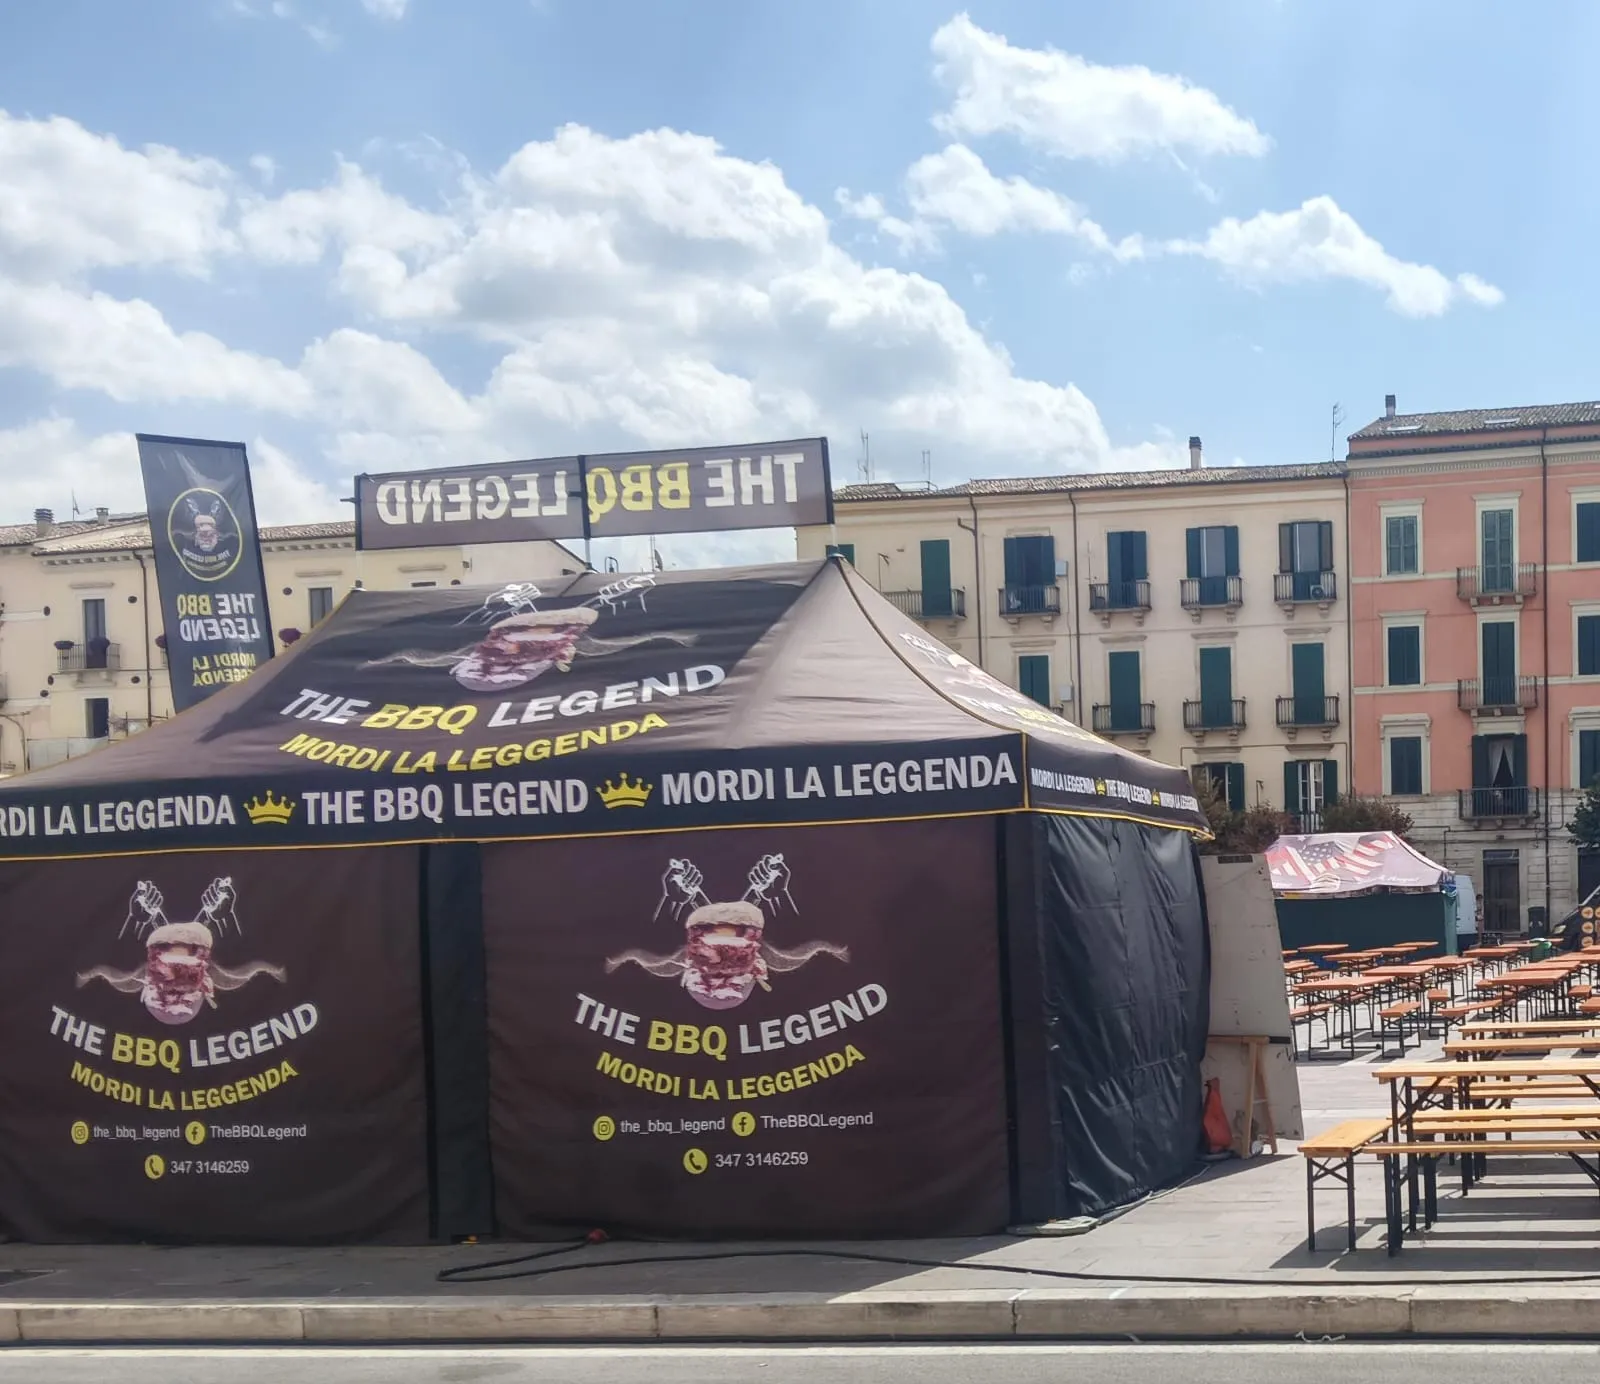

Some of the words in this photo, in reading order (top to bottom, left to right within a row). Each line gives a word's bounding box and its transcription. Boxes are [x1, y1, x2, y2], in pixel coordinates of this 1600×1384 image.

[280, 688, 370, 725] THE
[361, 704, 477, 735] BBQ
[487, 664, 725, 728] LEGEND
[279, 734, 391, 771] MORDI
[392, 749, 438, 774] LA
[447, 713, 668, 771] LEGGENDA
[301, 790, 365, 825] THE
[373, 785, 443, 824] BBQ
[454, 779, 589, 816] LEGEND
[661, 768, 775, 806] MORDI
[785, 766, 826, 799] LA
[833, 752, 1018, 796] LEGGENDA
[1031, 767, 1055, 790] MORDI
[1055, 772, 1064, 791] LA
[1064, 774, 1096, 795] LEGGENDA
[1105, 779, 1117, 797] THE
[44, 805, 77, 835] LA
[83, 794, 236, 834] LEGGENDA
[50, 1005, 106, 1056] THE
[111, 1032, 181, 1073] BBQ
[189, 1002, 318, 1067] LEGEND
[574, 991, 641, 1044] THE
[647, 1020, 728, 1061] BBQ
[738, 983, 889, 1053] LEGEND
[71, 1061, 141, 1106] MORDI
[149, 1088, 175, 1110] LA
[181, 1060, 299, 1110] LEGGENDA
[596, 1051, 680, 1096] MORDI
[688, 1078, 720, 1100] LA
[727, 1043, 866, 1100] LEGGENDA
[93, 1125, 180, 1141] the_bbq_legend
[210, 1124, 307, 1140] TheBBQLegend
[620, 1118, 725, 1137] the_bbq_legend
[760, 1112, 873, 1132] TheBBQLegend
[170, 1160, 192, 1174] 347
[195, 1160, 249, 1175] 3146259
[715, 1153, 741, 1168] 347
[746, 1152, 808, 1167] 3146259
